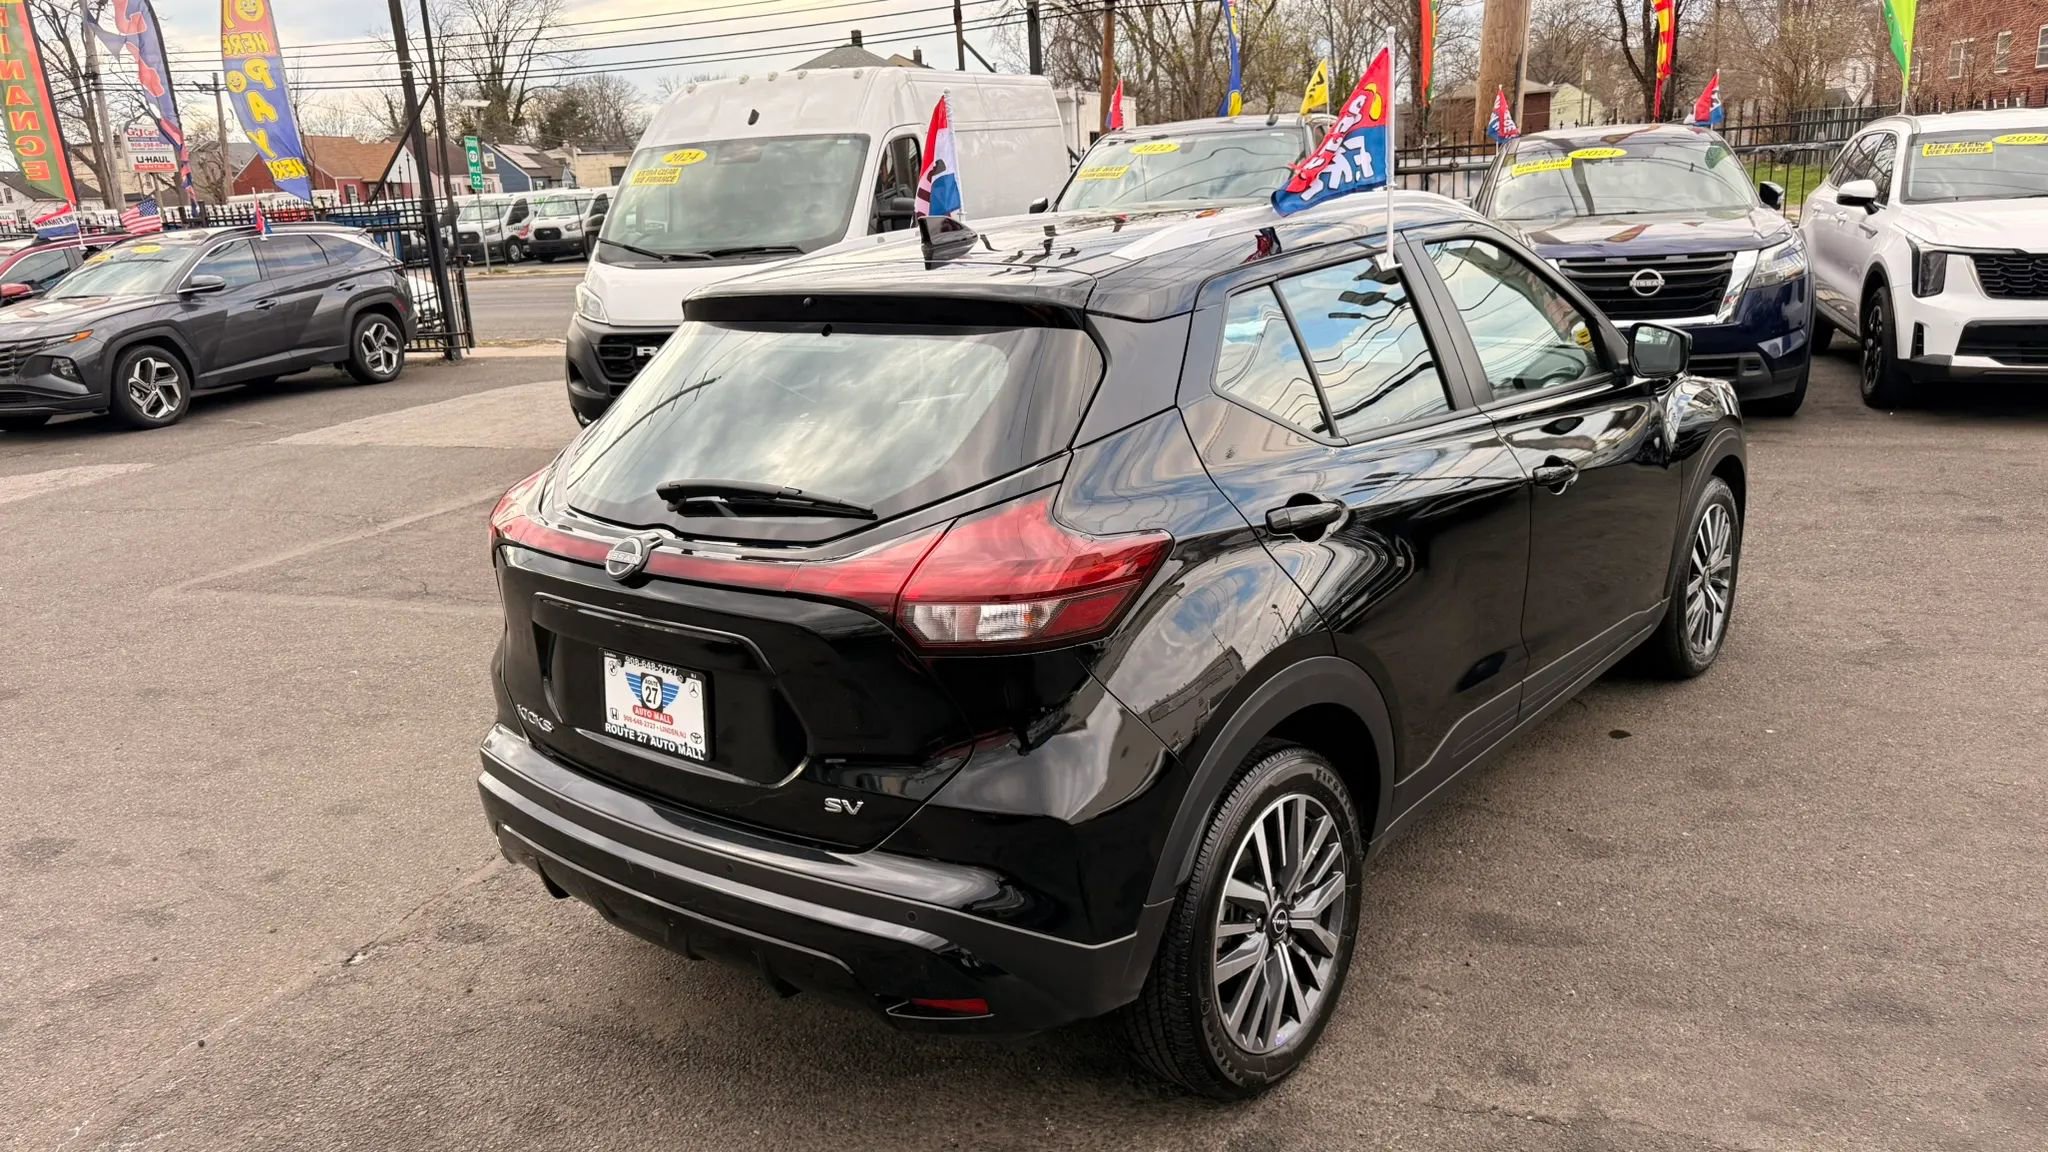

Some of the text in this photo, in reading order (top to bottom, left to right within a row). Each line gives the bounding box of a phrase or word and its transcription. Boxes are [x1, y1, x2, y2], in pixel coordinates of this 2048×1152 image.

[472, 175, 481, 185] 32
[645, 686, 658, 705] 27
[634, 706, 672, 723] AUTO MALL
[605, 722, 705, 761] ROUTE 27 AUTO MALL
[824, 797, 864, 815] SV
